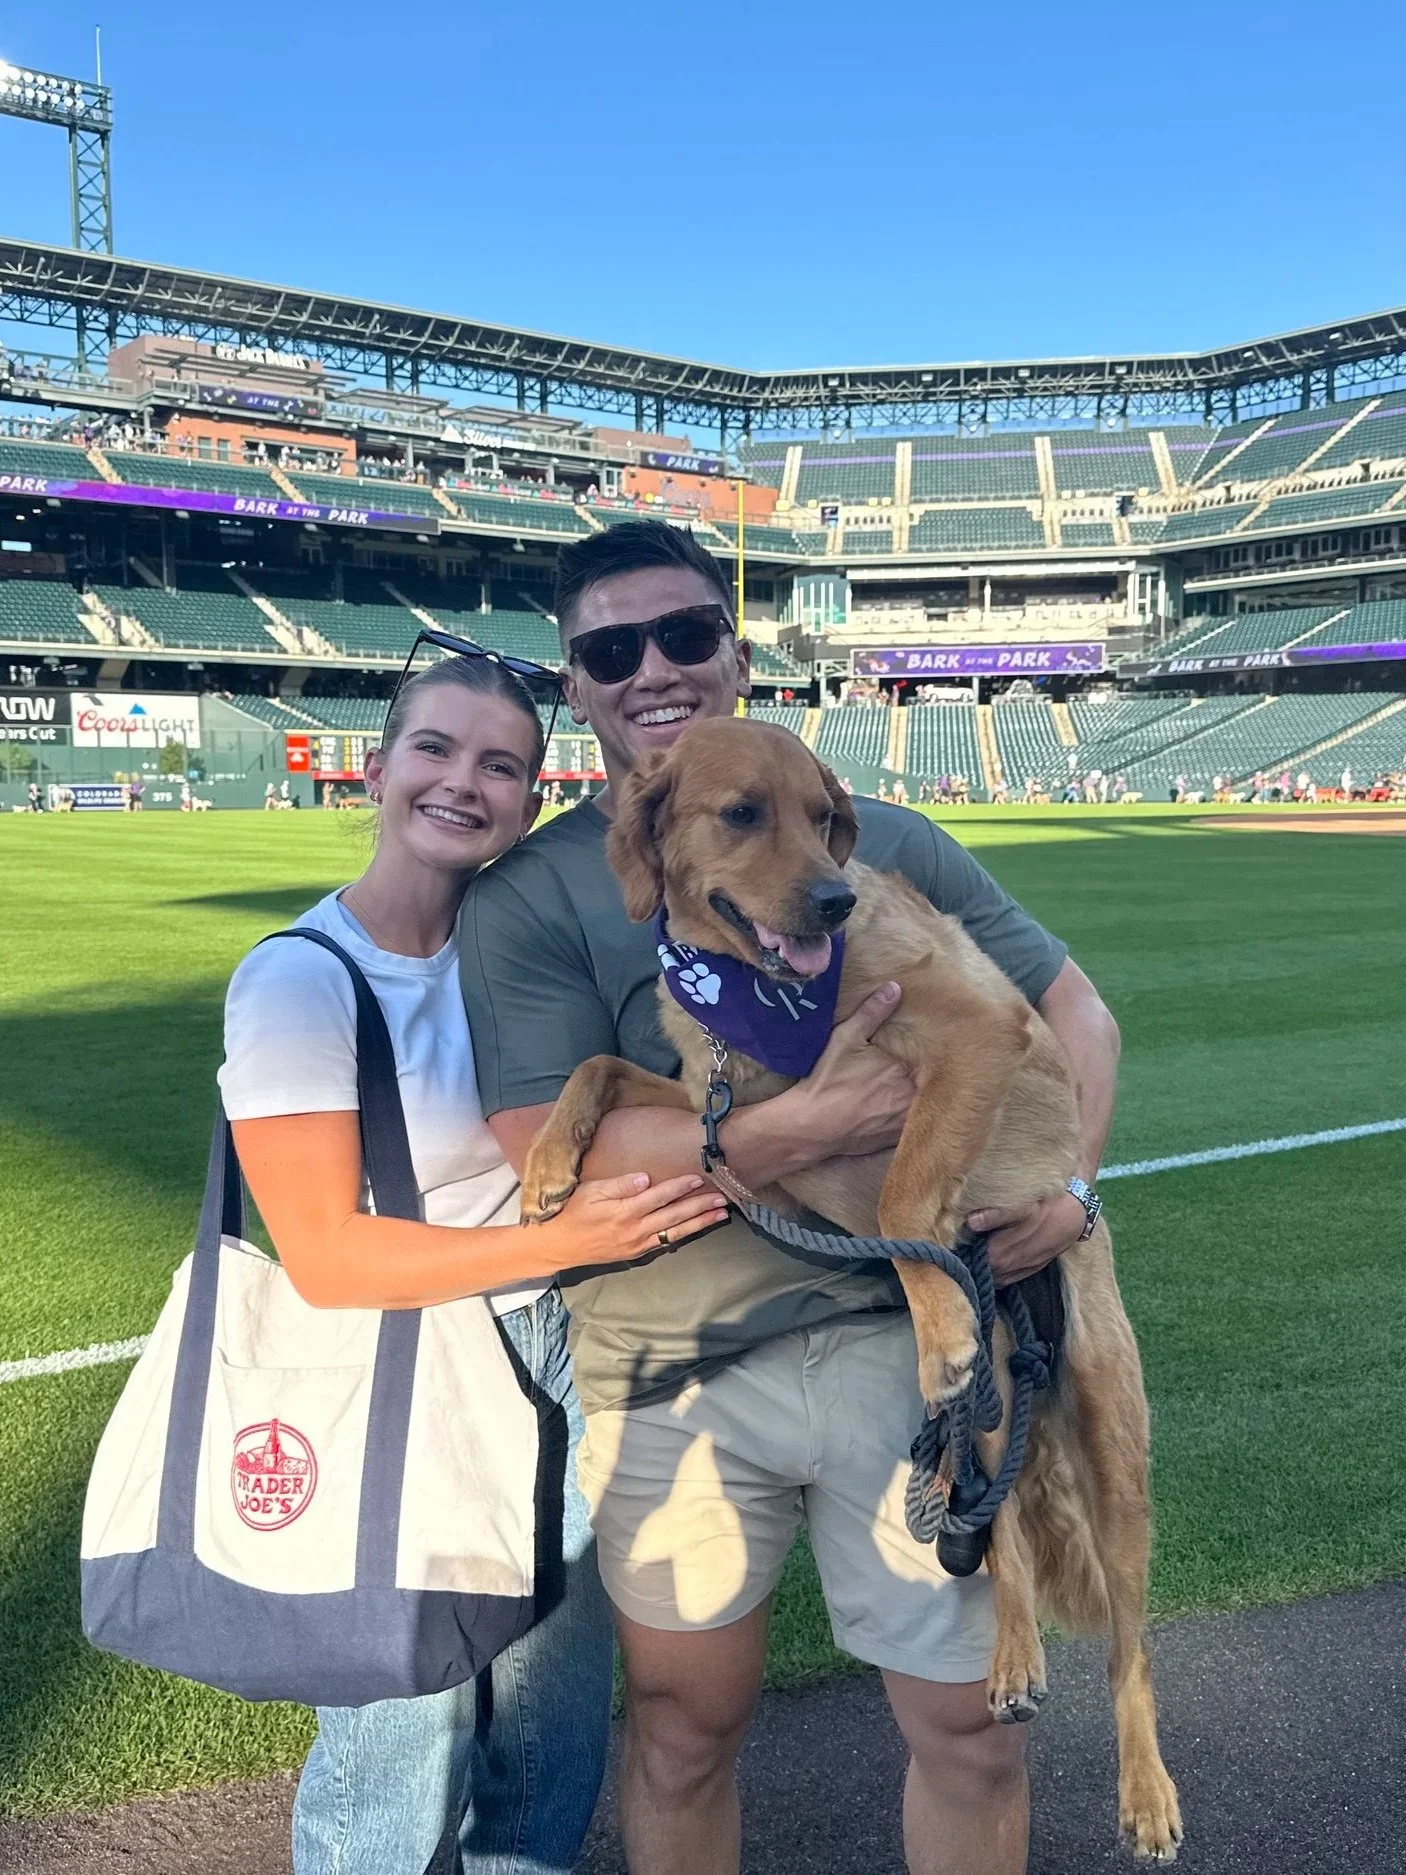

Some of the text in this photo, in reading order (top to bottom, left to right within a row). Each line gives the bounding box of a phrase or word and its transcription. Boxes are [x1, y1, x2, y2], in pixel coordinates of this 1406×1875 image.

[247, 396, 280, 408] AT THE
[666, 455, 701, 472] PARK
[0, 475, 48, 492] PARK
[233, 499, 369, 525] BARK AT THE PARK
[906, 653, 960, 670] BARK
[977, 657, 994, 665] THE
[996, 651, 1051, 668] PARK
[1168, 653, 1281, 673] BARK AT THE PARK
[77, 709, 195, 733] Coors LIGHT
[28, 726, 56, 740] Cut
[237, 1471, 304, 1494] TRADER
[240, 1494, 294, 1514] JOE'S
